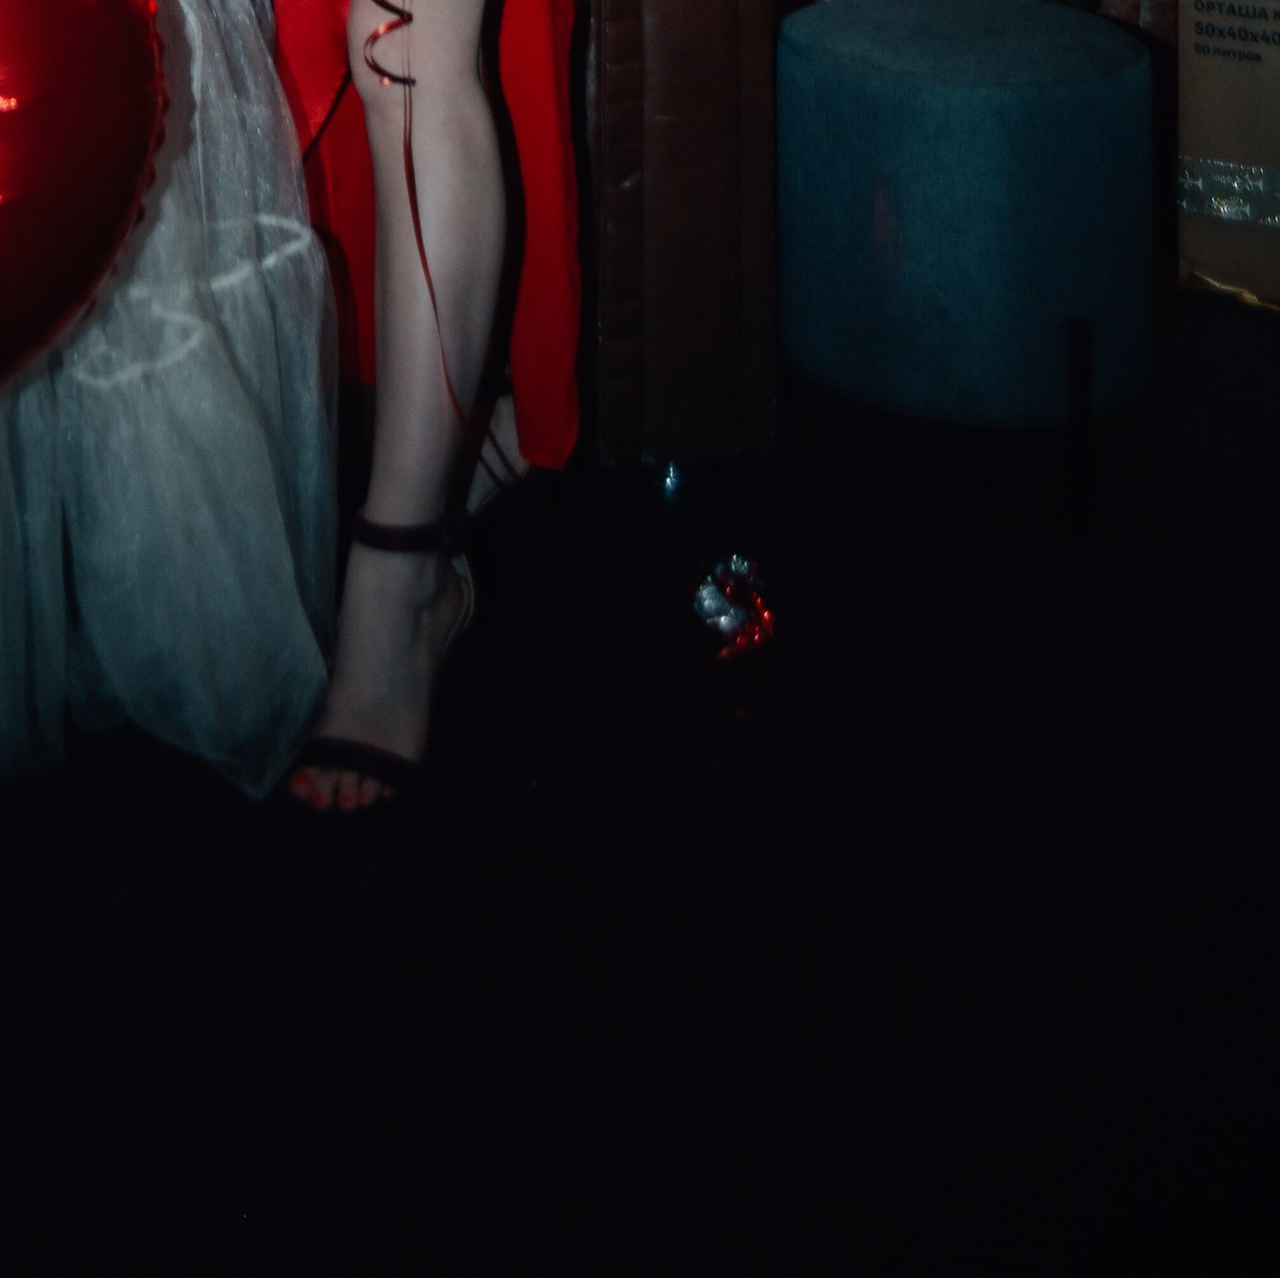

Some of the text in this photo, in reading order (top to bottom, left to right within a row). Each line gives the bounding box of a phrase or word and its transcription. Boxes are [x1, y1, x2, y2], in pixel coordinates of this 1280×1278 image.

[1194, 0, 1269, 20] ОРТАША
[1194, 43, 1261, 61] 80 литров
